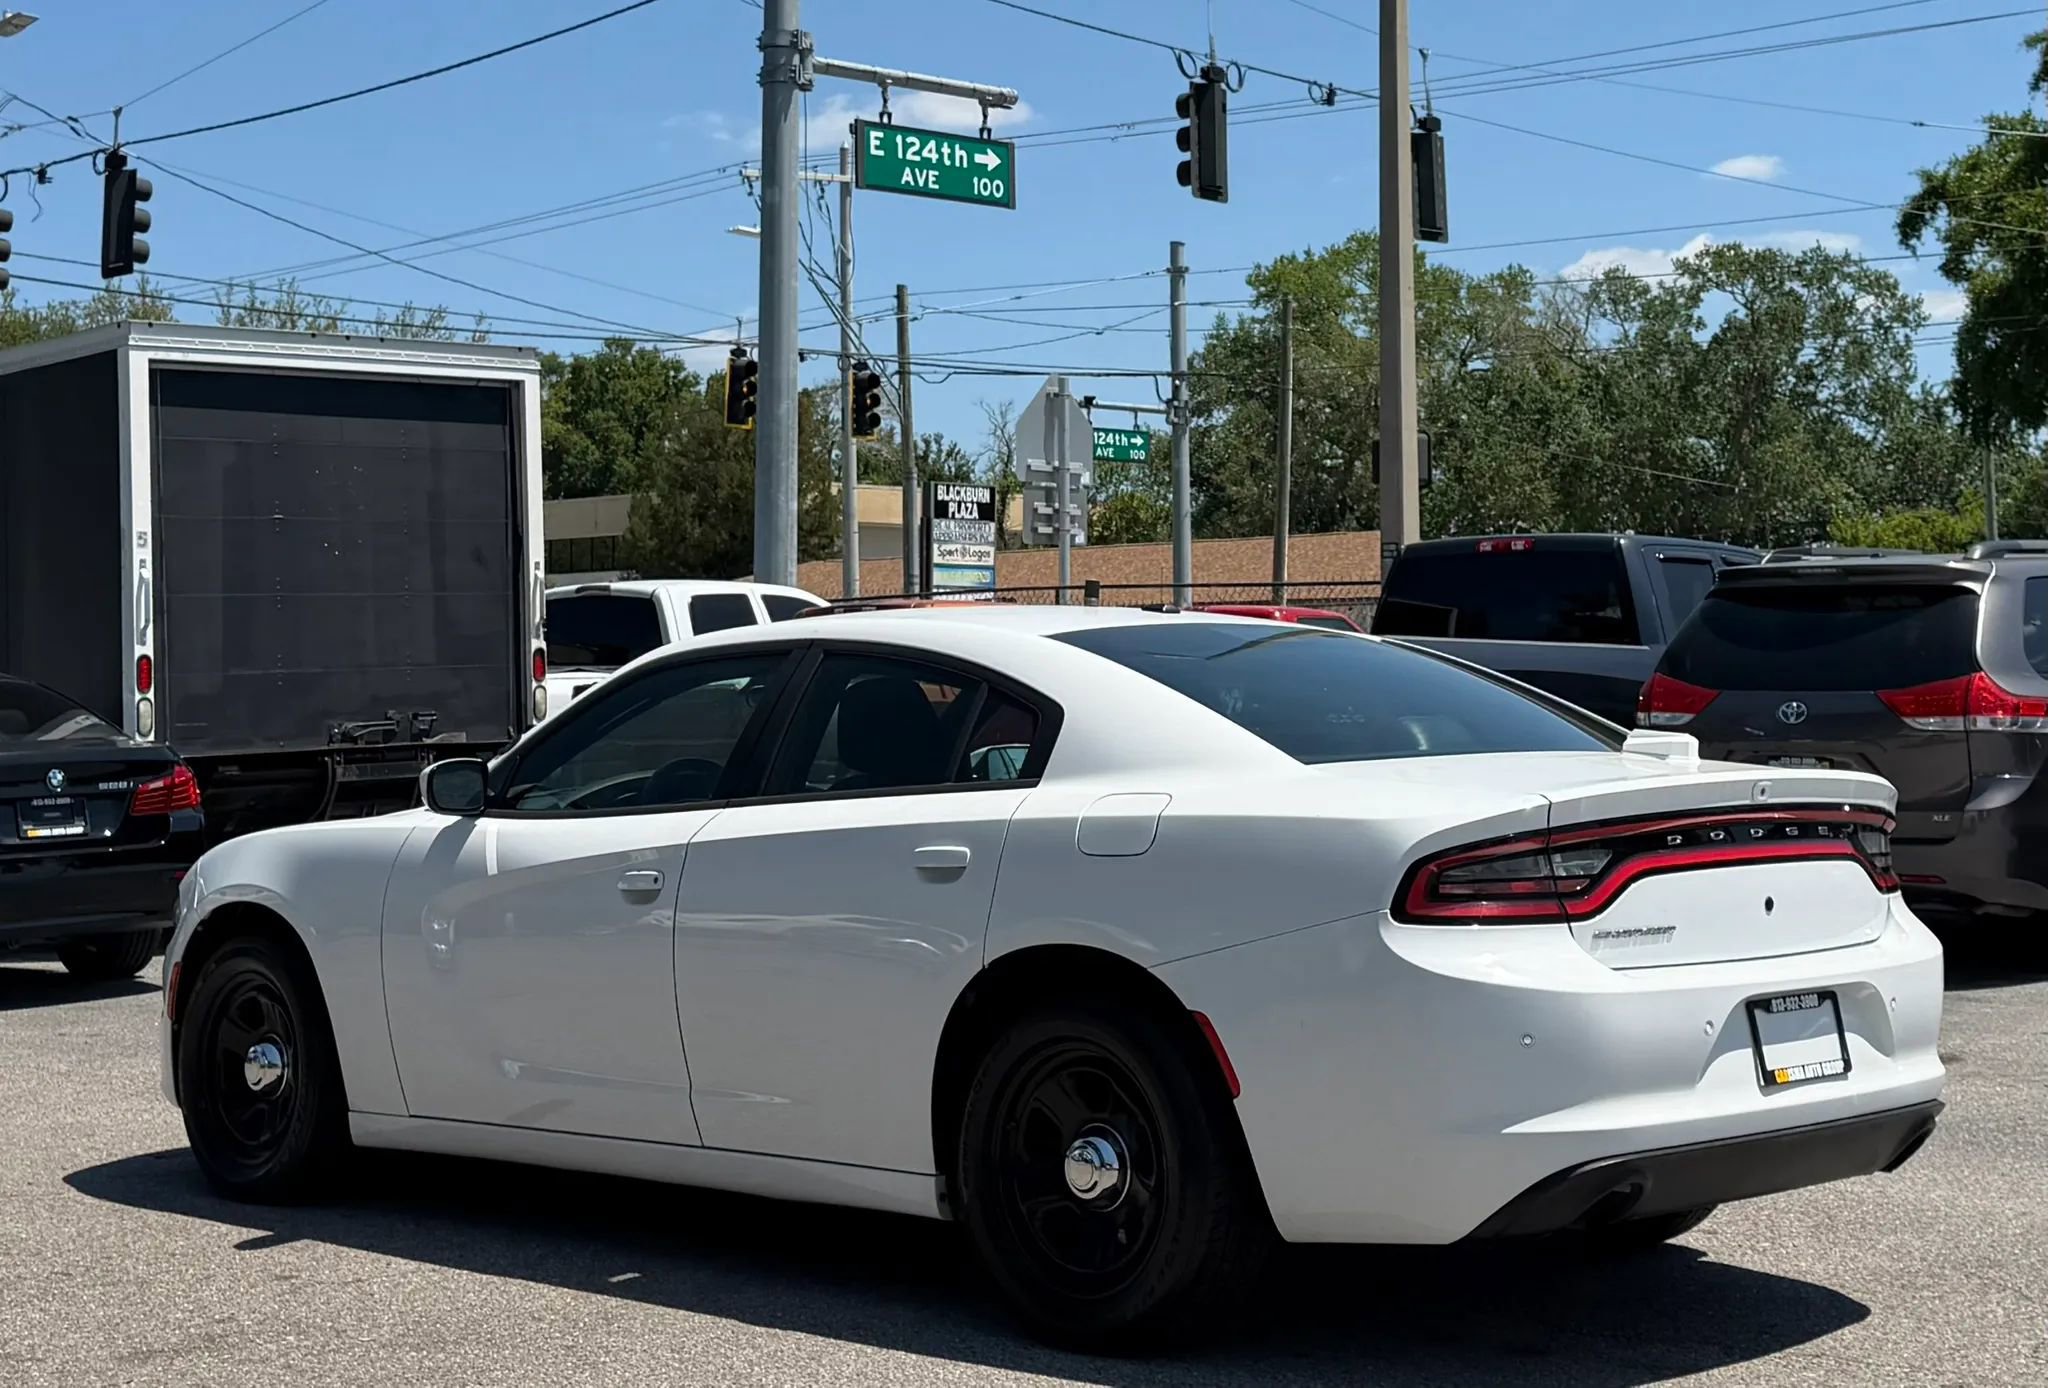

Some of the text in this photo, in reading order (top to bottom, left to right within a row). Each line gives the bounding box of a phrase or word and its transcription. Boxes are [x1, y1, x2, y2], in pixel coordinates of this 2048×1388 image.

[869, 130, 968, 168] E 124th
[901, 166, 1004, 198] AVE 100
[1093, 431, 1128, 446] 124th
[1096, 447, 1146, 460] AVE 100
[937, 485, 990, 503] BLACKBURN
[948, 503, 979, 519] PLAZA
[937, 544, 991, 562] Sport Logos
[1667, 826, 1829, 846] DODGE
